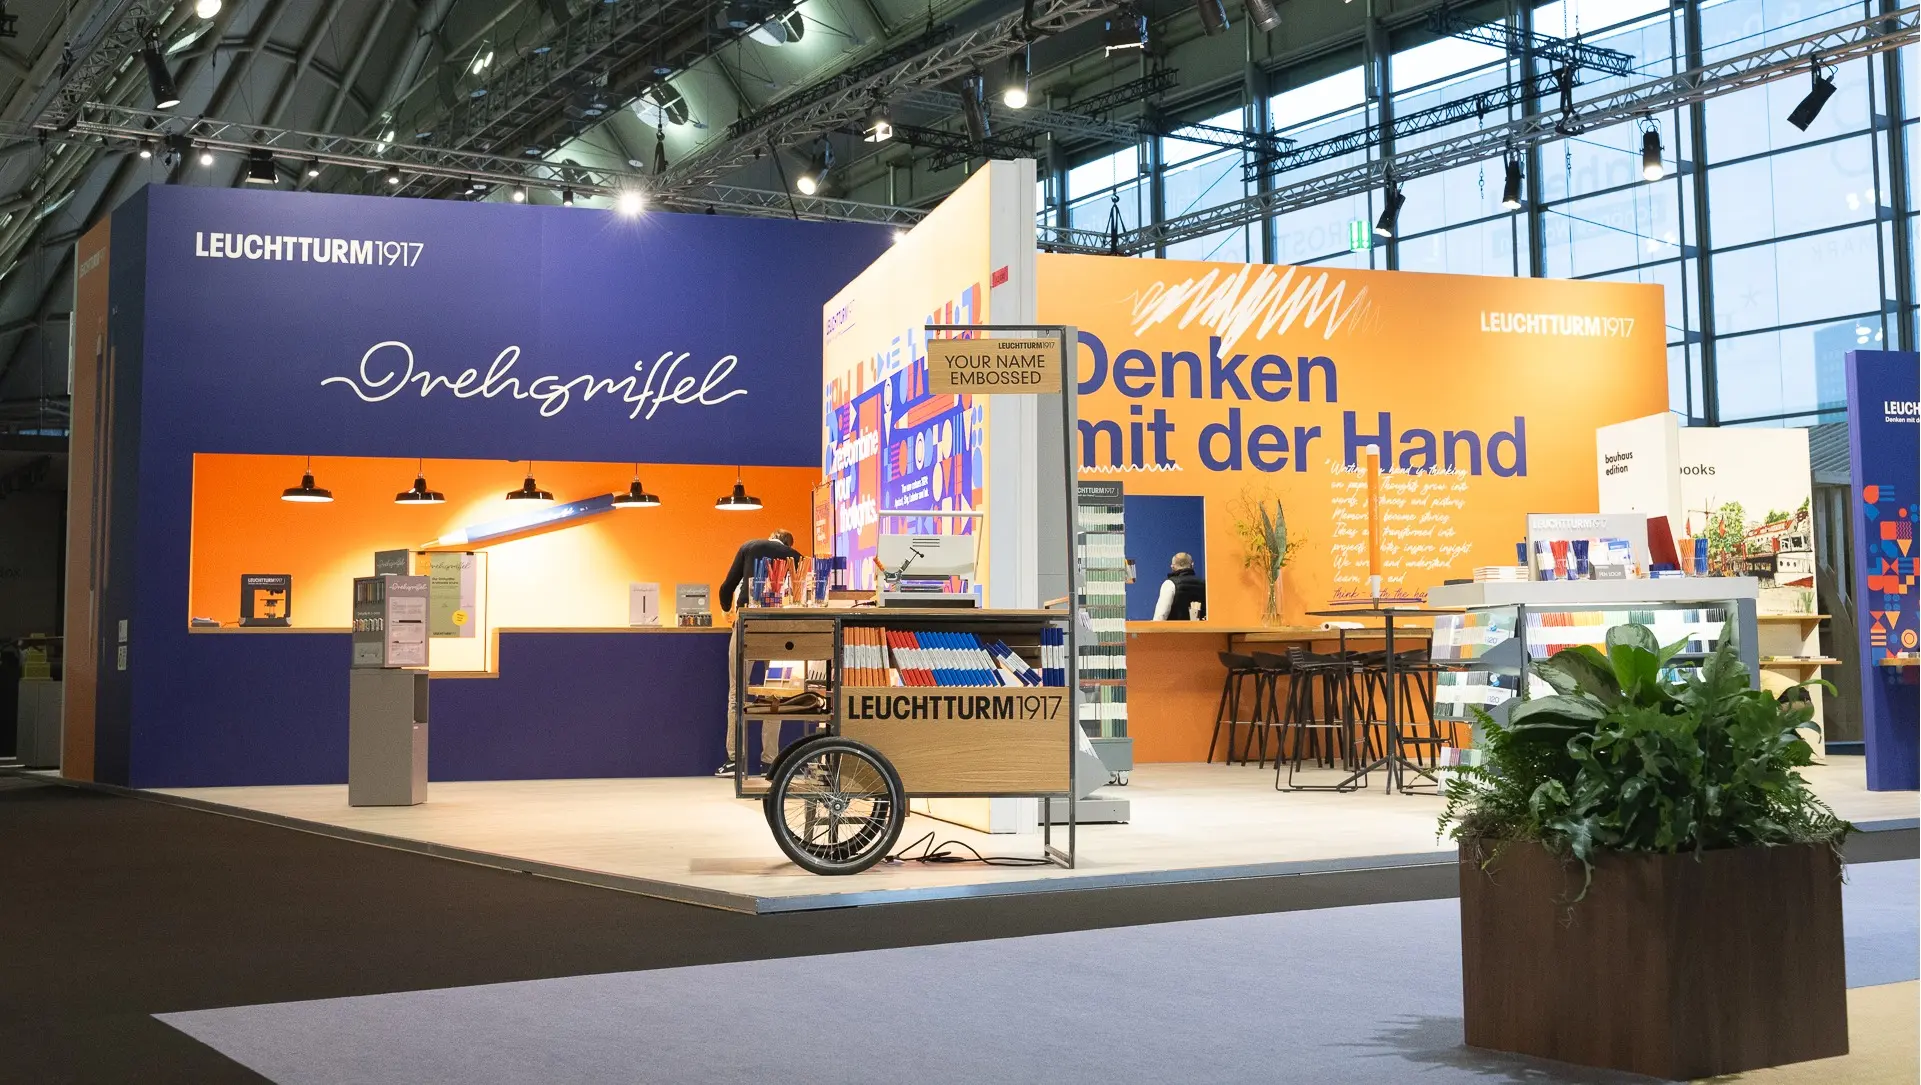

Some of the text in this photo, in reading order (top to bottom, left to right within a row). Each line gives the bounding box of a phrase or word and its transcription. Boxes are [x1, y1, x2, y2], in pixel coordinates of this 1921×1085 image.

[195, 232, 424, 267] LEUCHTTURM1917
[1480, 310, 1635, 338] LEUCHTTURM1917
[945, 354, 1045, 369] YOUR NAME
[1077, 330, 1338, 403] Denken
[950, 371, 1041, 385] EMBOSSED
[1198, 407, 1321, 473] der
[1342, 410, 1527, 478] Hand
[1604, 450, 1633, 464] bauhaus
[1428, 463, 1468, 481] thinking
[1605, 464, 1629, 476] edition
[848, 695, 1063, 720] LEUCHTTURM1917
